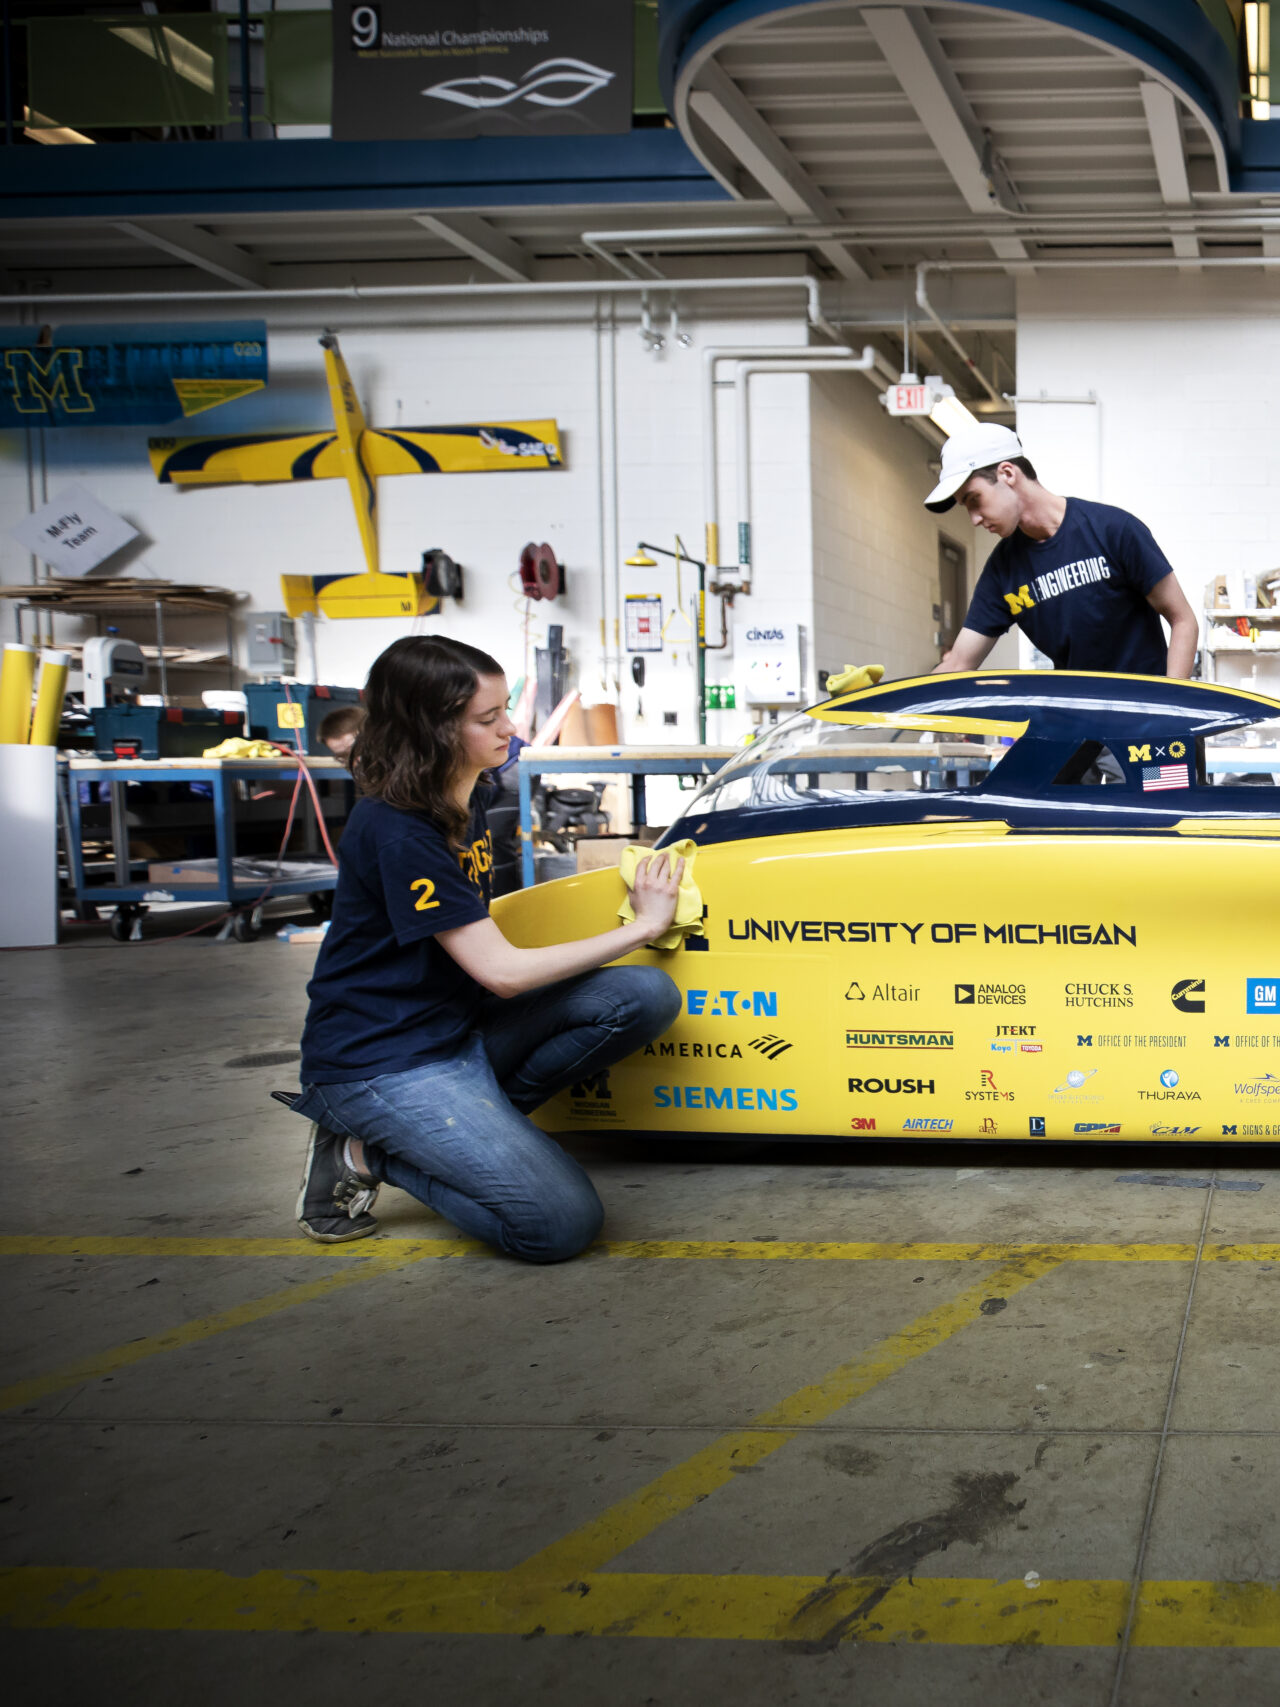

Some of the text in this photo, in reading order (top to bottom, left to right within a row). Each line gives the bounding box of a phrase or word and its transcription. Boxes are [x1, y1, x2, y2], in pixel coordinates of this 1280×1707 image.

[352, 6, 550, 47] 9 National Championships
[5, 349, 95, 413] M
[897, 385, 925, 409] EXIT
[62, 526, 98, 549] Team
[1003, 584, 1036, 615] M
[1128, 744, 1152, 762] M
[410, 878, 440, 911] 2
[728, 917, 924, 945] UNIVERSITY
[931, 923, 977, 944] OF
[984, 923, 1137, 947] MICHIGAN
[872, 983, 920, 1001] Altair
[978, 984, 1026, 994] ANALOG
[1065, 983, 1134, 995] CHUCK S.
[1172, 979, 1203, 1001] Cummins
[1254, 985, 1277, 1002] GM
[687, 990, 778, 1017] EATON
[978, 995, 1026, 1005] DEVICES
[1065, 997, 1134, 1008] HUTCHINS
[995, 1025, 1037, 1037] JTEKT
[846, 1033, 954, 1046] HUNTSMAN
[1077, 1035, 1187, 1048] M OFFICE OF THE PRESIDENT
[1213, 1035, 1230, 1047] M
[1235, 1035, 1259, 1047] OFFICE
[1261, 1035, 1270, 1047] OF
[643, 1043, 742, 1058] AMERICA
[991, 1043, 1012, 1053] Koyo
[848, 1078, 935, 1094] ROUSH
[653, 1086, 798, 1111] SIEMENS
[965, 1091, 1015, 1101] SYSTEMS
[1137, 1090, 1202, 1101] THURAYA
[851, 1117, 876, 1130] 3M
[902, 1118, 954, 1130] AIRTECH
[1222, 1124, 1238, 1136] M
[1242, 1124, 1263, 1136] SIGNS
[1265, 1124, 1271, 1136] &
